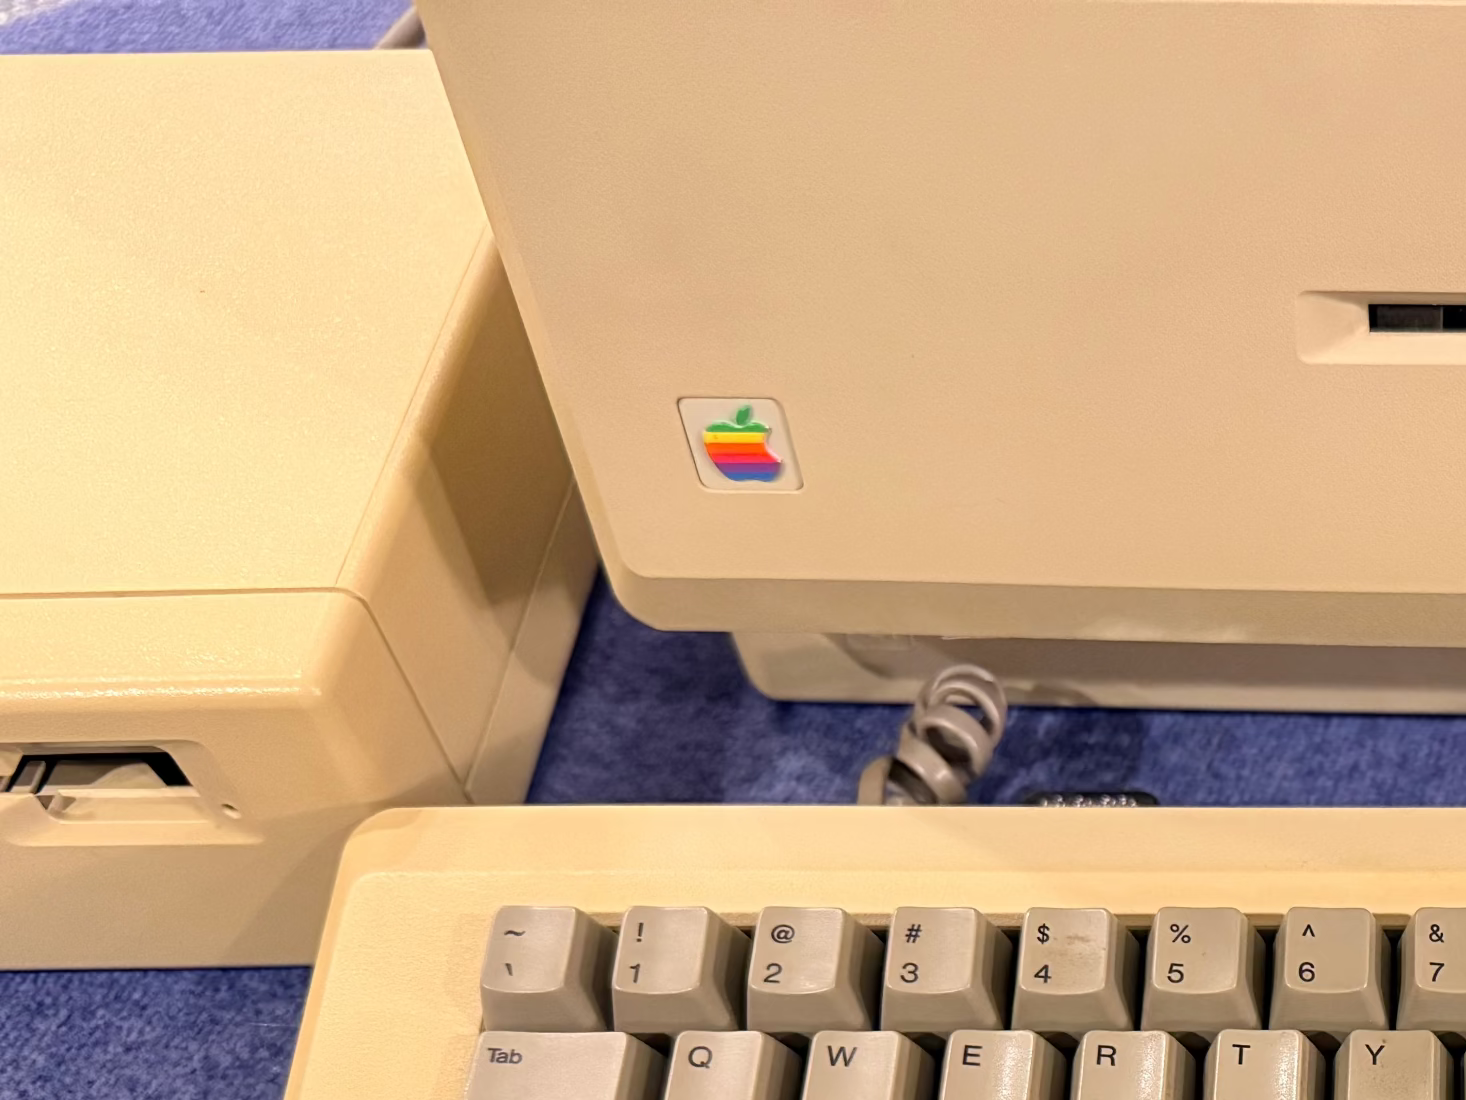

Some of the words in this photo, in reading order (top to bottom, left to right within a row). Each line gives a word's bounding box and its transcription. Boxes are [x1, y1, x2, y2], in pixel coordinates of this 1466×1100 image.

[504, 929, 526, 937] ~
[636, 922, 644, 943] !
[770, 924, 795, 944] @
[904, 923, 922, 944] #
[1036, 922, 1050, 945] $
[1169, 923, 1192, 944] %
[1302, 923, 1316, 938] ^
[1428, 923, 1445, 943] &
[629, 963, 641, 984] 1
[762, 962, 783, 984] 2
[900, 962, 919, 984] 3
[1033, 964, 1052, 984] 4
[1167, 962, 1185, 984] 5
[1298, 961, 1316, 983] 6
[1429, 961, 1445, 982] 7
[487, 1047, 523, 1065] Tab
[687, 1045, 713, 1069] Q
[827, 1045, 857, 1067] W
[961, 1044, 983, 1067] E
[1096, 1044, 1117, 1067] R
[1231, 1043, 1251, 1065] T
[1365, 1043, 1385, 1066] Y
